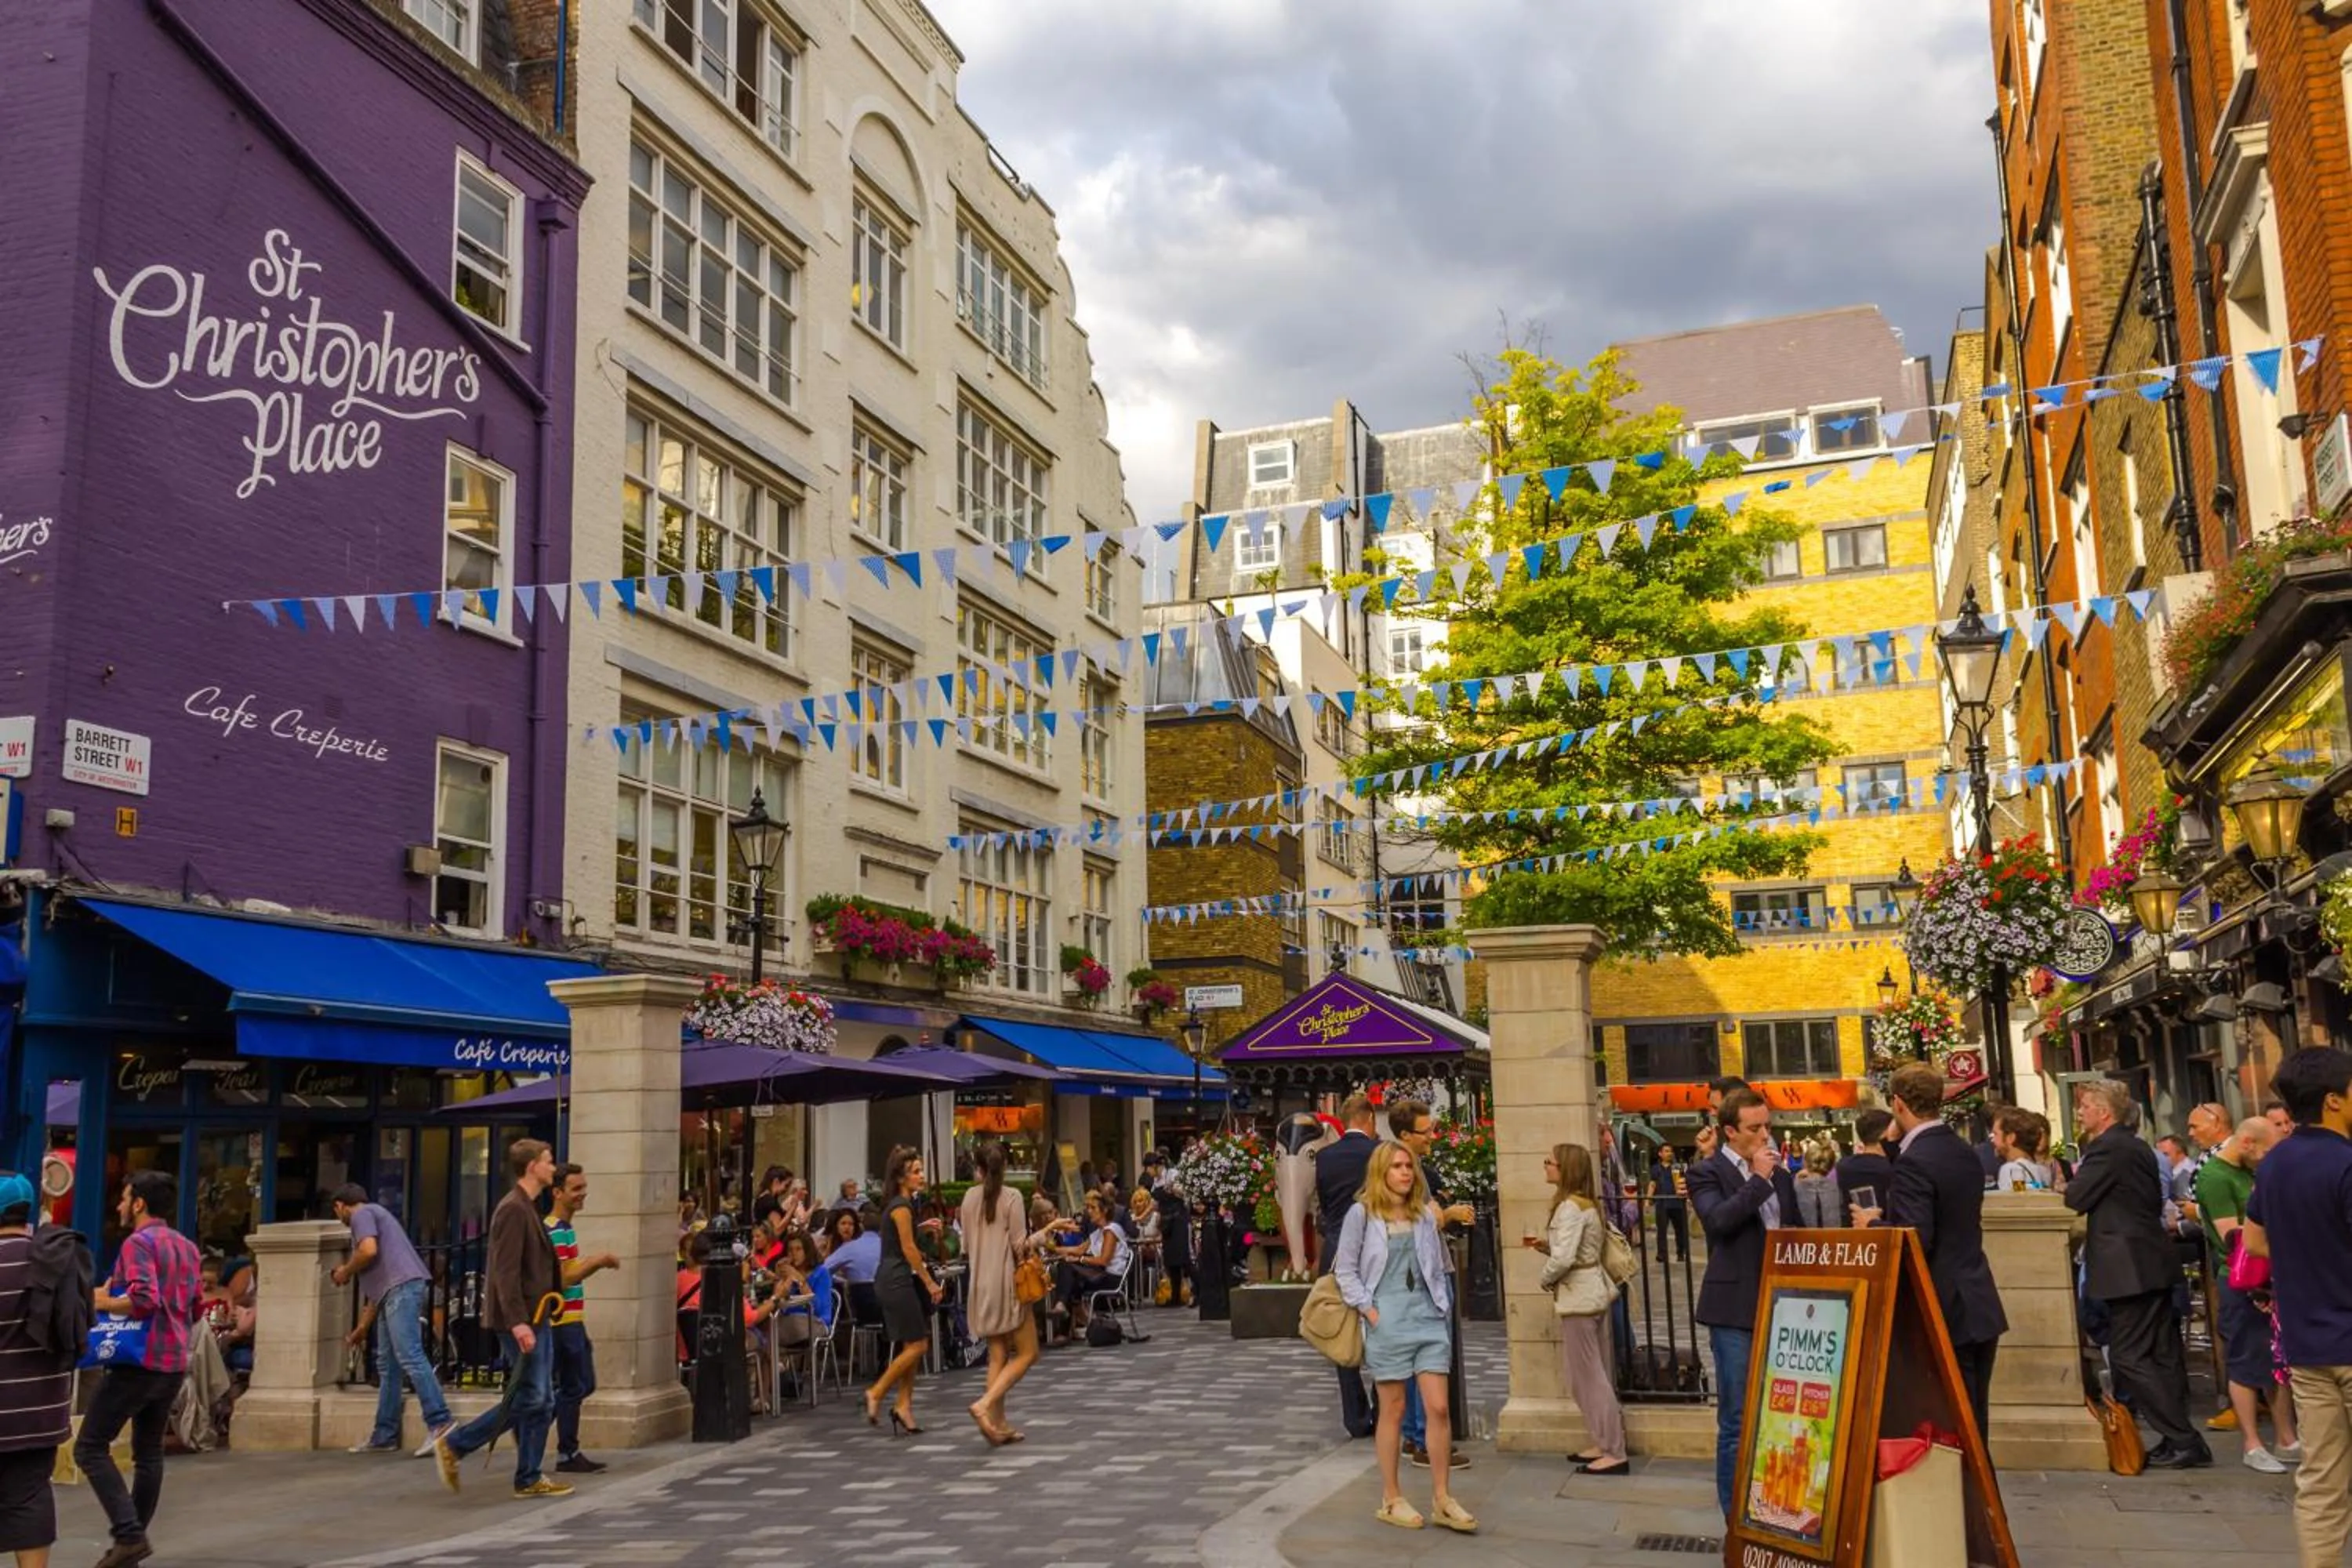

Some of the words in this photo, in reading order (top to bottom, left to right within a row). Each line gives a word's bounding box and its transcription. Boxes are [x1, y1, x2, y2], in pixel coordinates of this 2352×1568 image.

[249, 228, 321, 301] St
[93, 263, 481, 419] Christopher's
[175, 390, 383, 499] Place
[184, 686, 259, 737] Cafe
[270, 709, 390, 761] Creperie
[7, 742, 27, 758] W1
[76, 728, 131, 753] BARRETT
[74, 746, 121, 768] STREET
[125, 757, 143, 775] W1
[118, 810, 135, 835] H
[454, 1038, 496, 1067] Café
[500, 1041, 570, 1069] Creperie
[1774, 1243, 1817, 1265] LAMB
[1818, 1242, 1831, 1265] &
[1835, 1243, 1878, 1266] FLAG
[1777, 1327, 1837, 1355] PIMM'S
[1776, 1352, 1835, 1374] O'CLOCK
